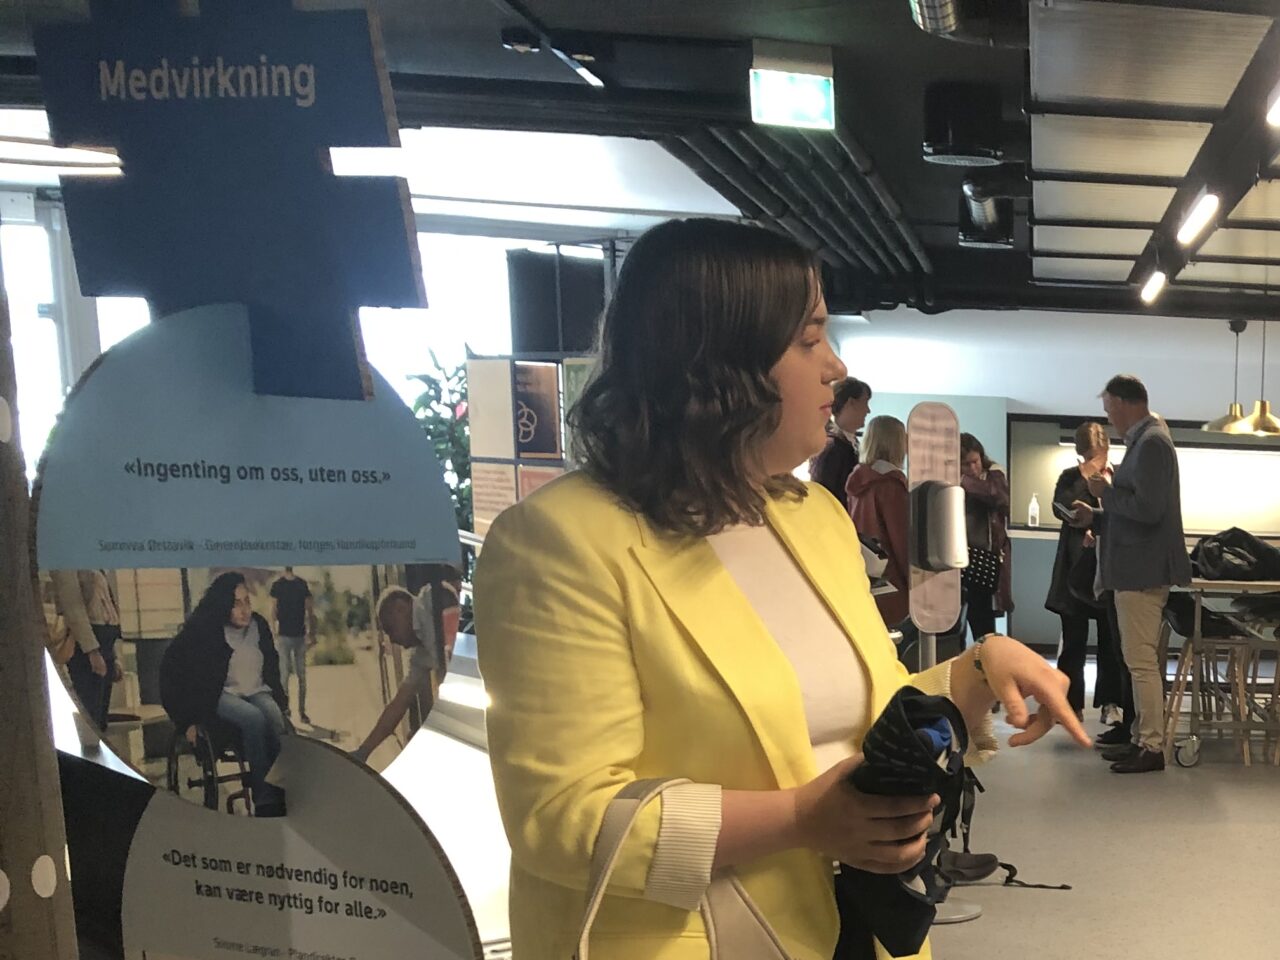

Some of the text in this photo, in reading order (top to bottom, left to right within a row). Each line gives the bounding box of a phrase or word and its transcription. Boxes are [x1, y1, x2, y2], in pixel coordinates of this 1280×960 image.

[98, 54, 316, 108] Medvirkning
[124, 457, 392, 486] «Ingenting om oss, uten oss.»
[163, 848, 414, 900] «Det som er nødvendig for noen,
[195, 878, 387, 921] kan være nyttig for alle.»
